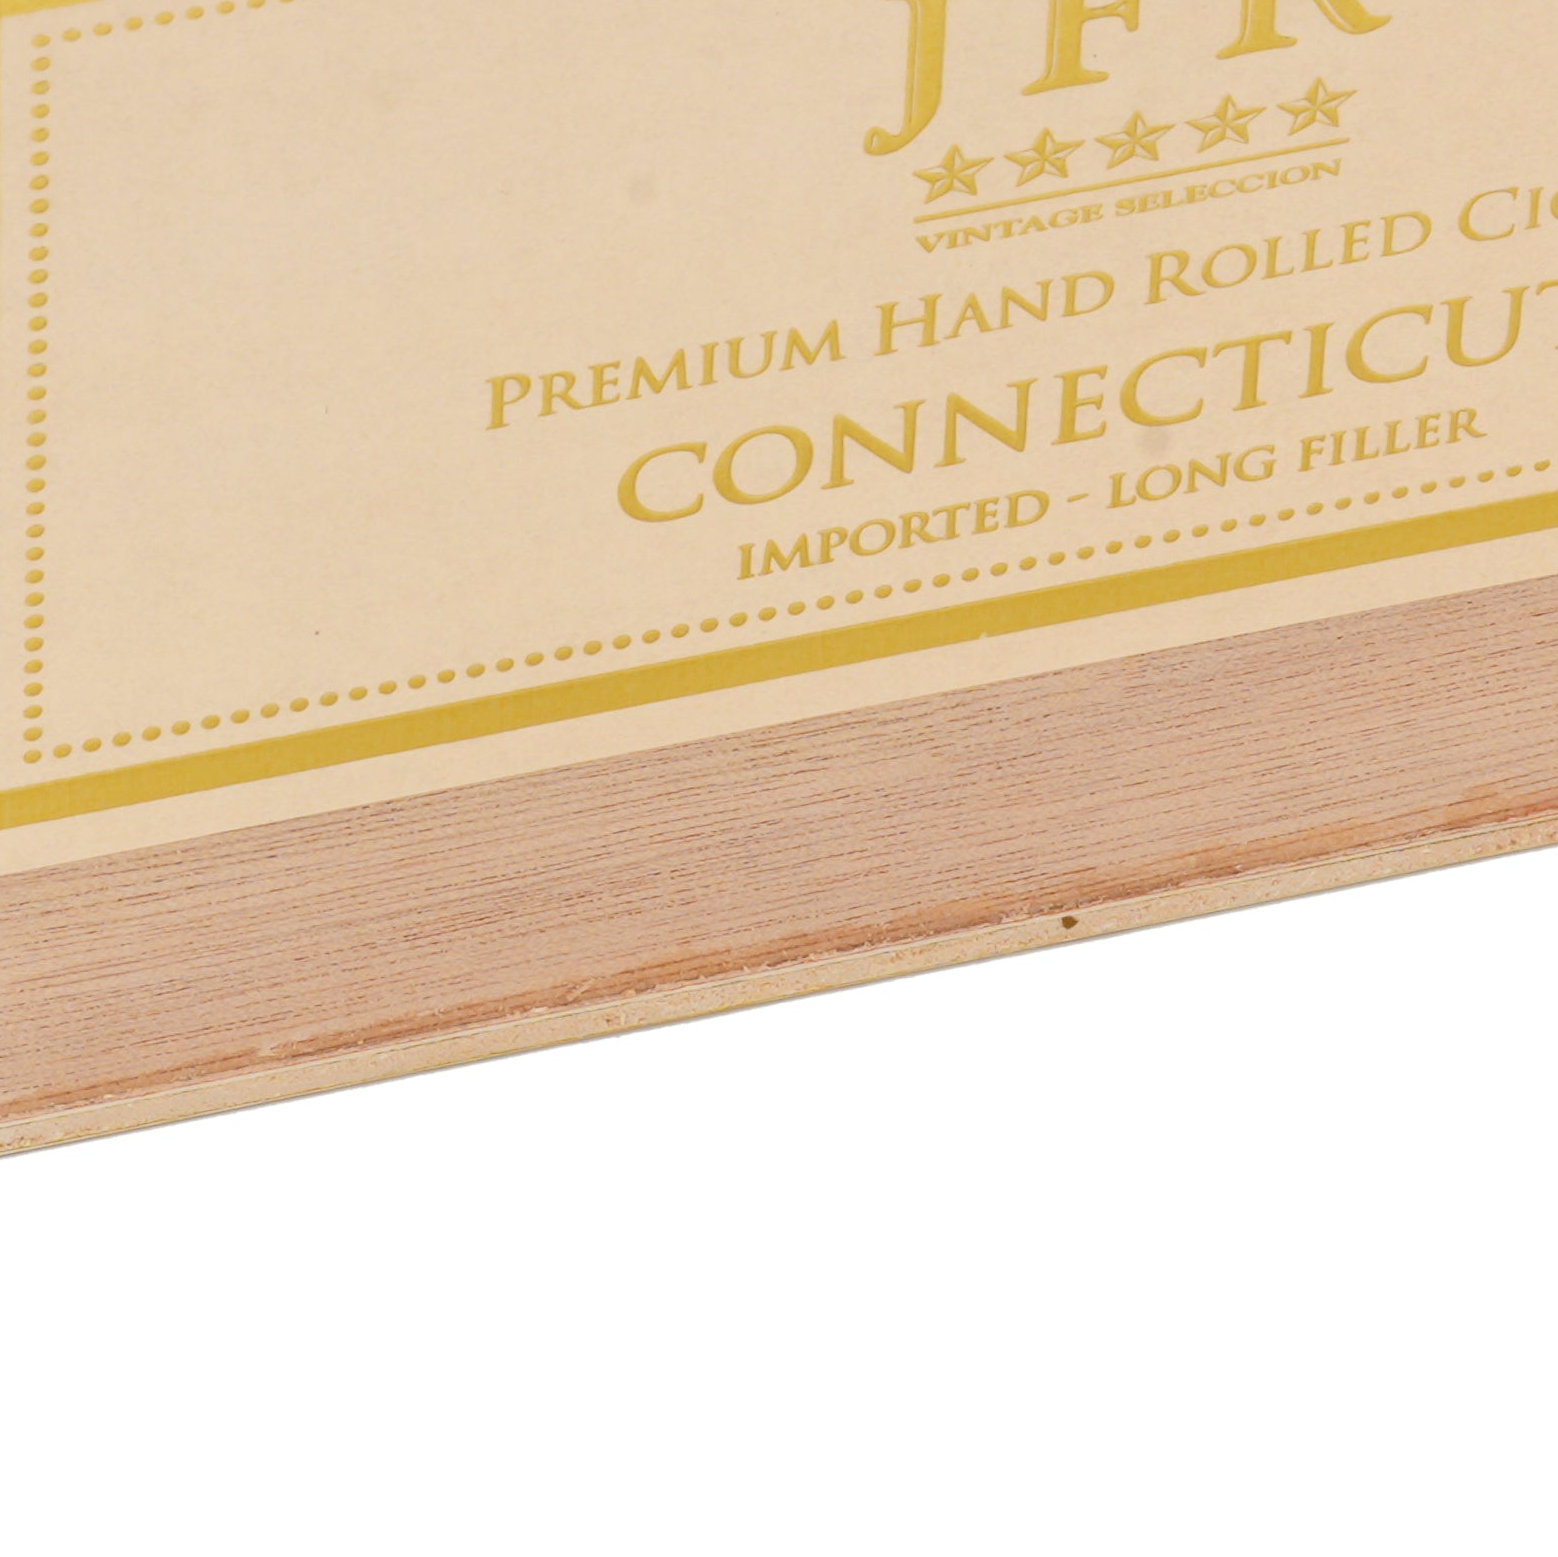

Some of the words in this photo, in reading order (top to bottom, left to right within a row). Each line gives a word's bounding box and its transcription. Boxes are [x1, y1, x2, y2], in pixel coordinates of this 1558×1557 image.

[914, 203, 1104, 254] VINTAGE
[1114, 157, 1343, 217] SELECCION
[483, 318, 847, 431] PREMIUM
[875, 268, 1116, 359] HAND
[1142, 209, 1434, 307] ROLLED
[734, 488, 1052, 582] IMPORTED
[1105, 445, 1277, 511] LONG
[1298, 406, 1488, 476] FILLER
